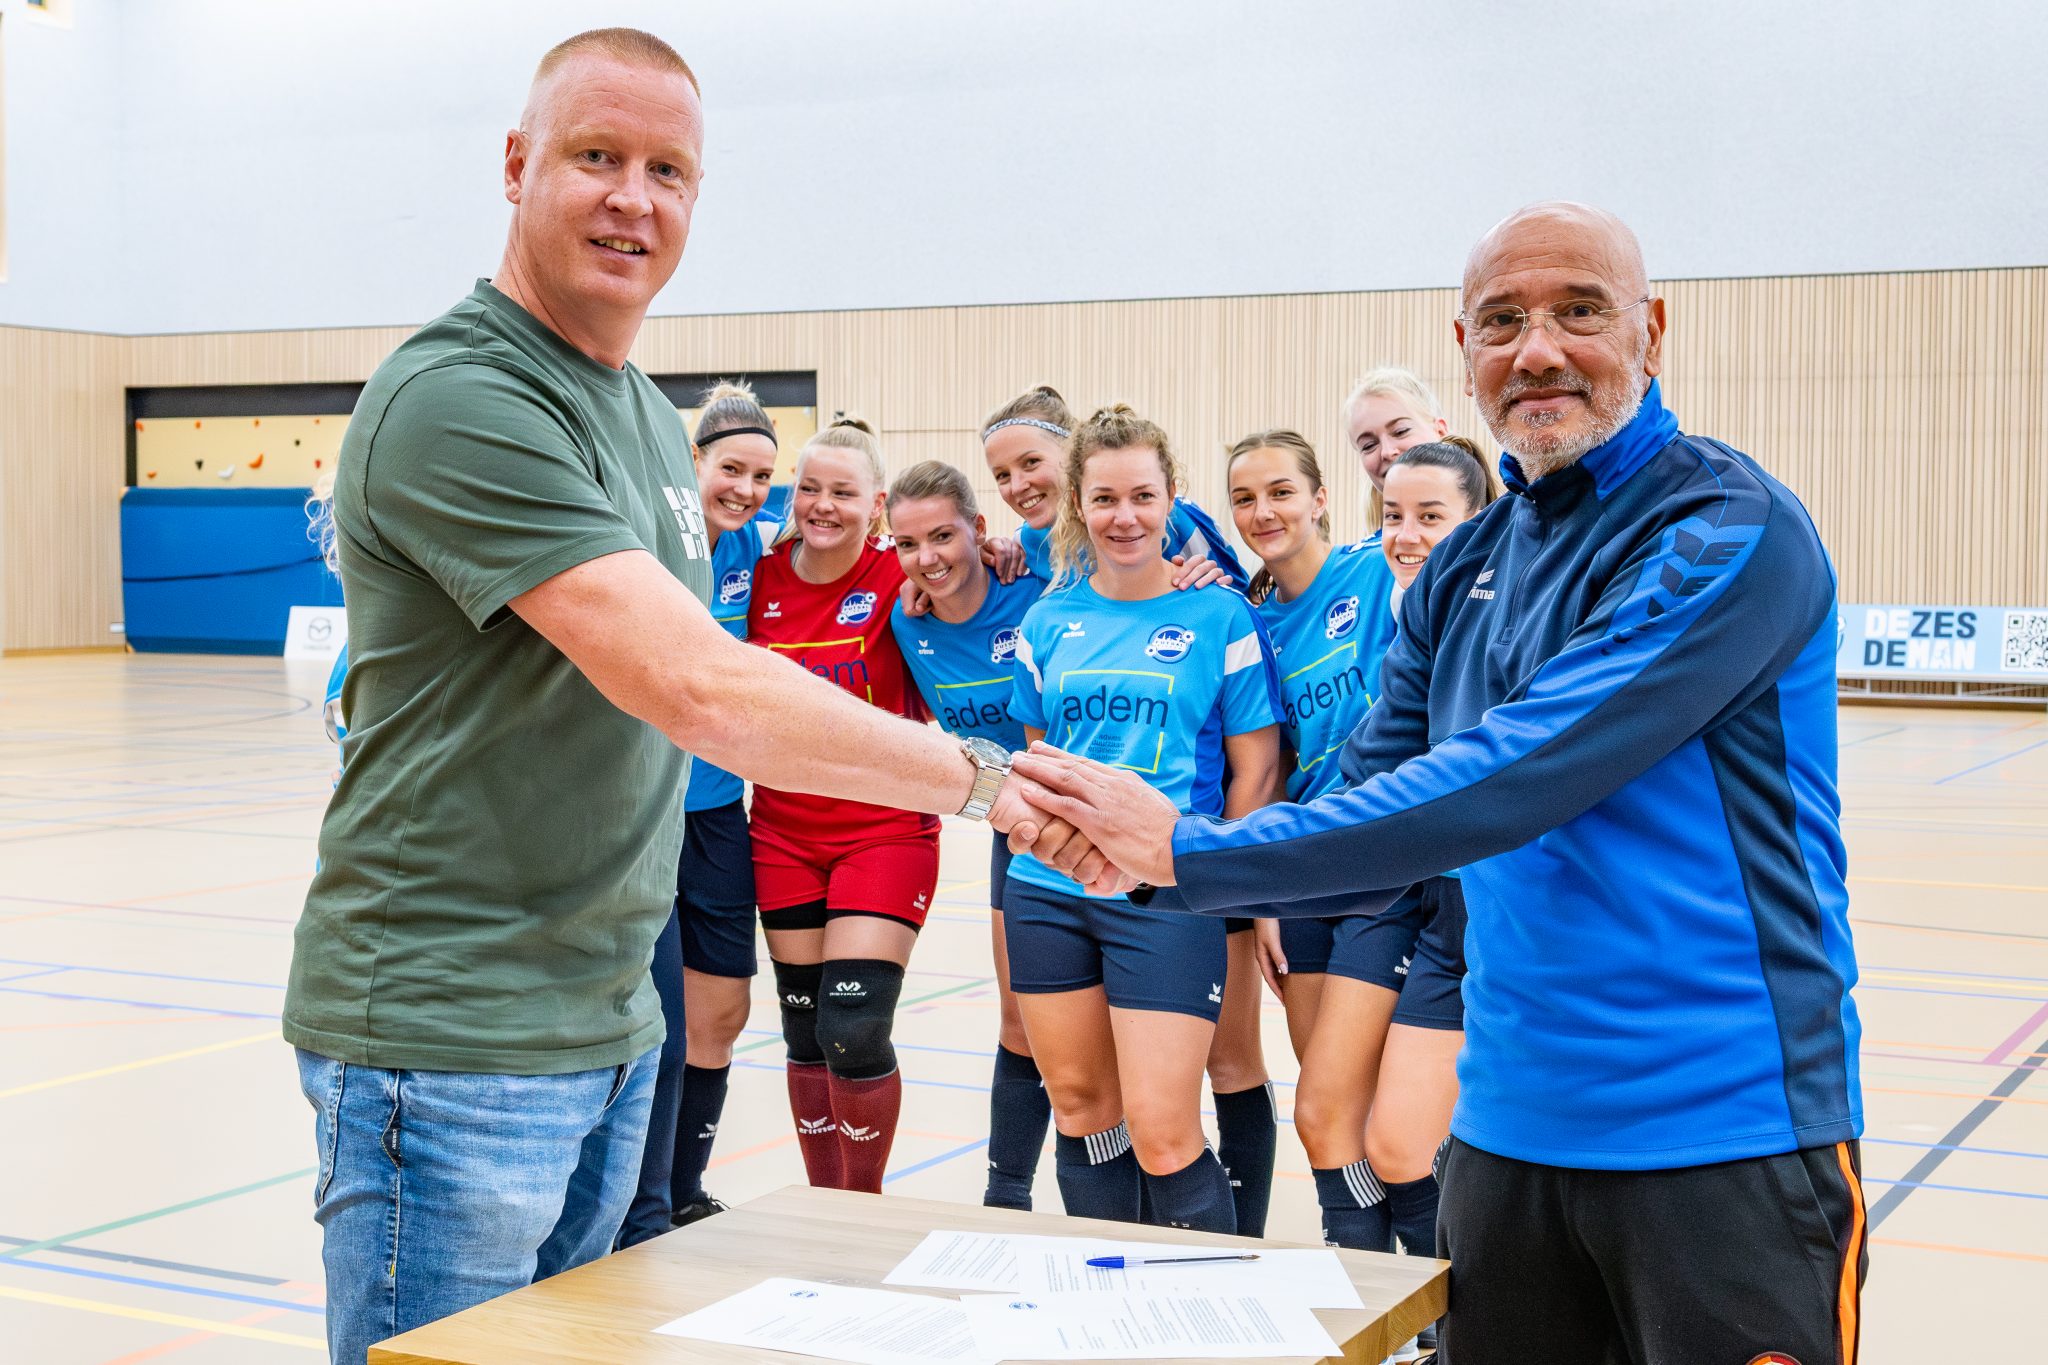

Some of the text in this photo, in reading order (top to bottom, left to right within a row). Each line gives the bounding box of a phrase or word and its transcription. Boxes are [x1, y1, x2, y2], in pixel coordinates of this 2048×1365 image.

[1864, 608, 1977, 639] DEZES
[1863, 640, 1976, 670] DEMAN
[1062, 685, 1168, 728] adem
[1285, 666, 1367, 730] adem
[798, 1124, 837, 1135] erima
